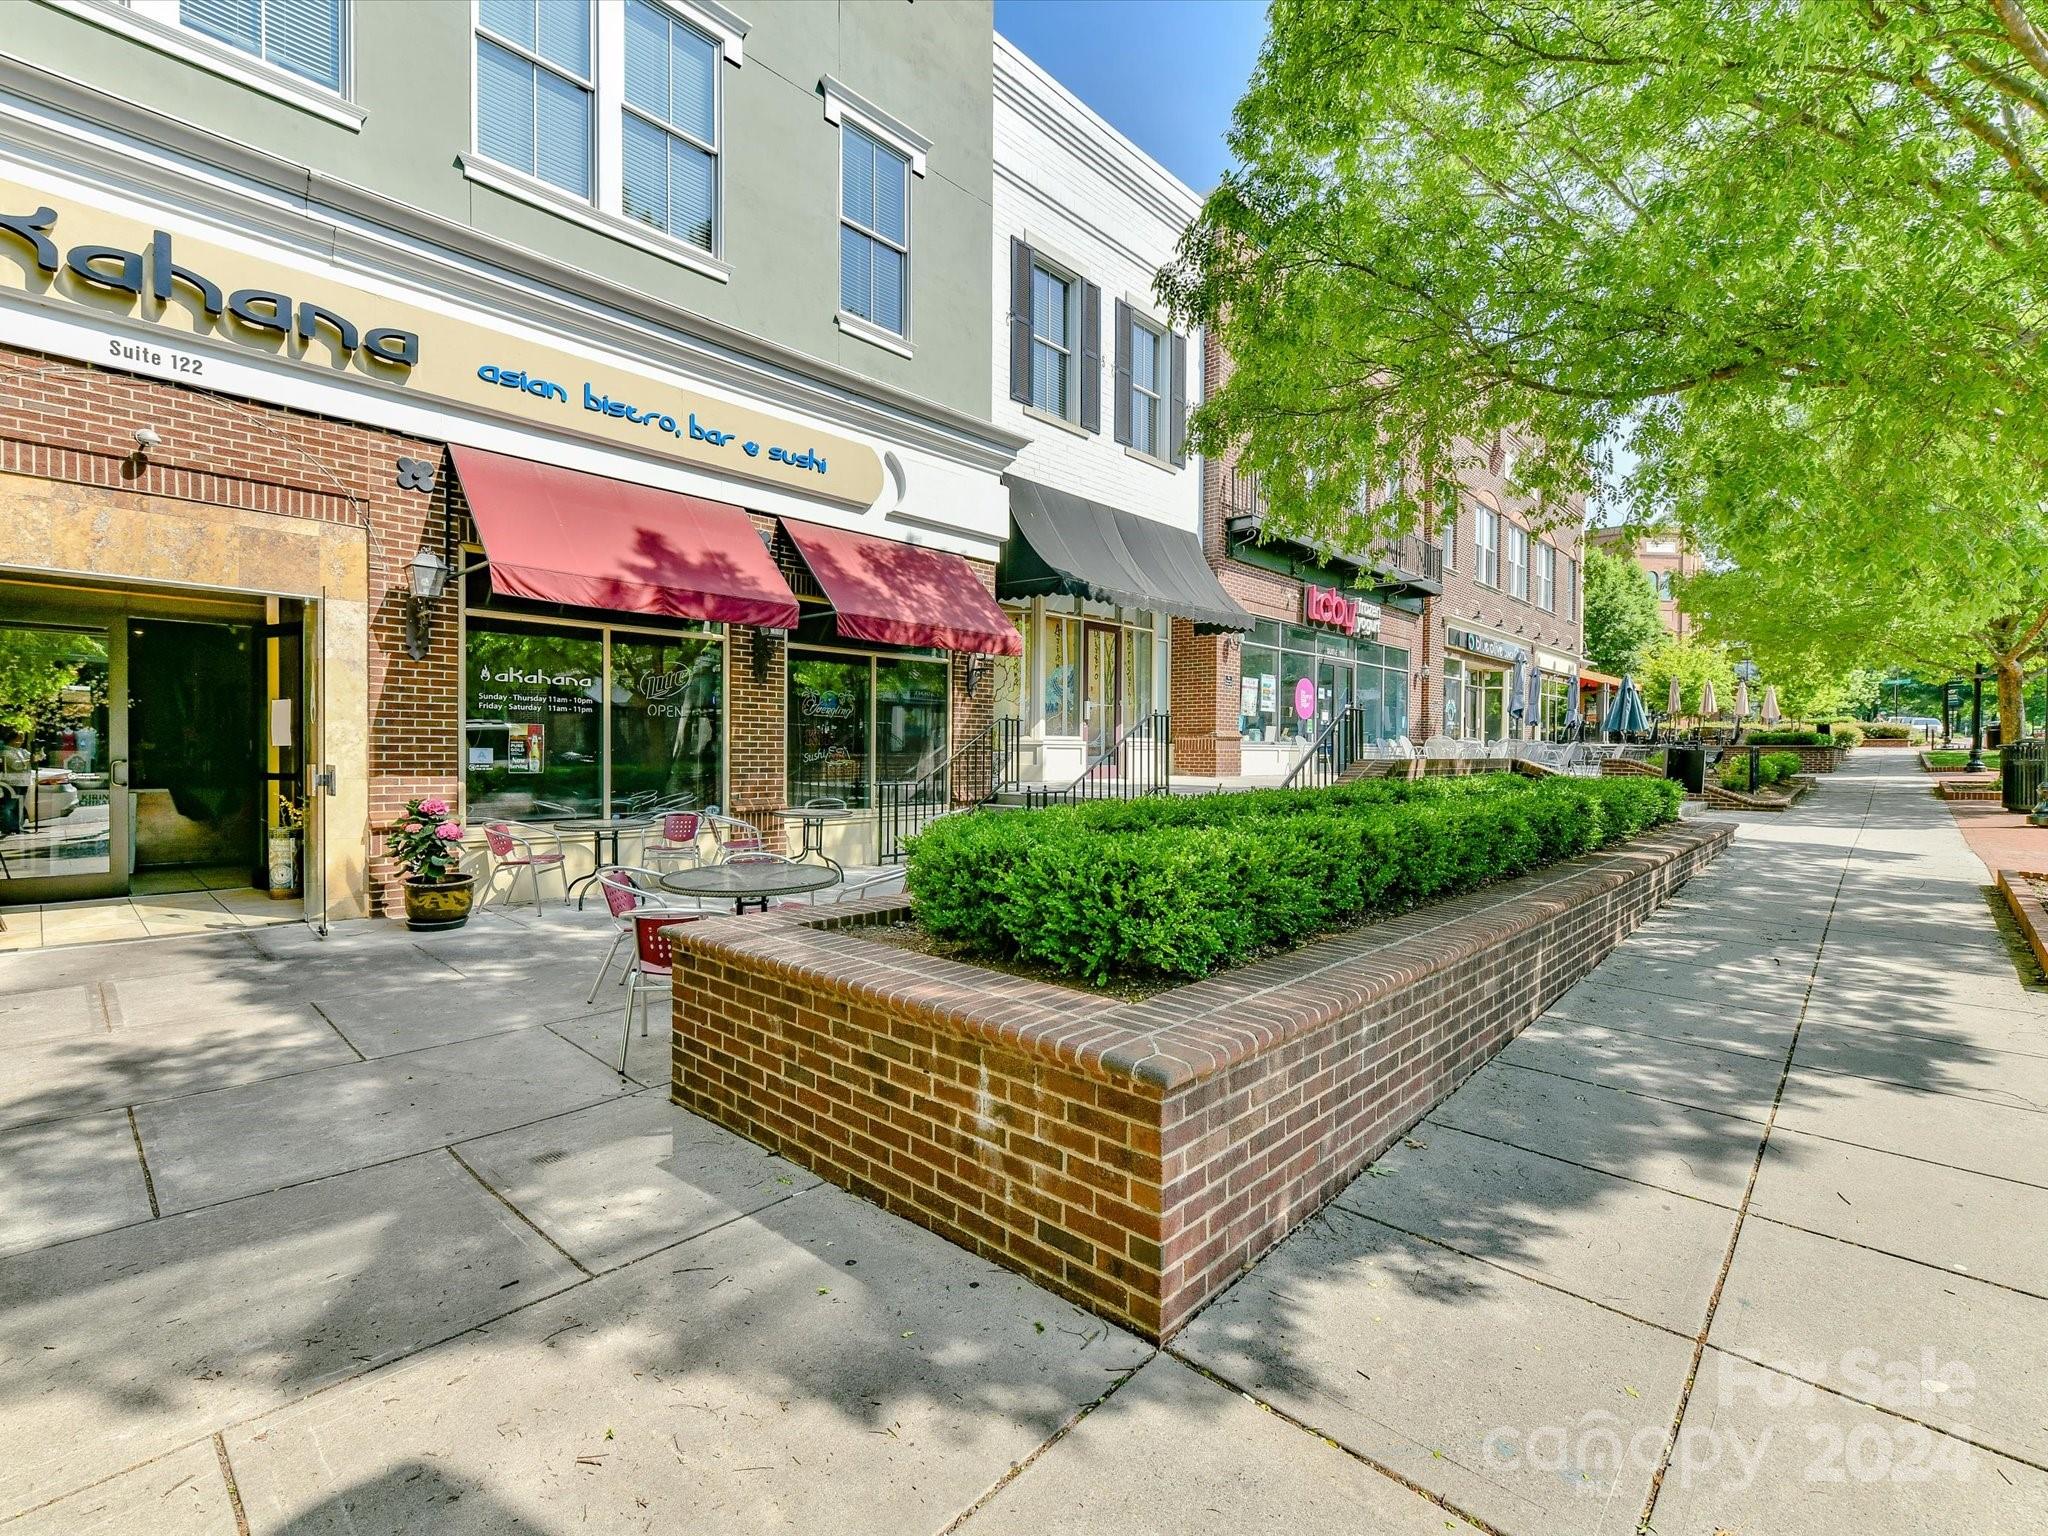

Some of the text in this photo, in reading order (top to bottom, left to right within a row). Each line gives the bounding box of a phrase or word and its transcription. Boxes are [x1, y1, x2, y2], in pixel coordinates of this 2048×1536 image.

[109, 340, 203, 376] Suite 122
[477, 364, 568, 403] asian
[583, 382, 681, 438] bistro,
[688, 413, 736, 447] bar
[768, 447, 827, 474] sushi
[478, 692, 507, 701] Sunday
[513, 694, 547, 703] Thursday
[574, 697, 593, 705] 10pm
[478, 702, 503, 711] Friday
[509, 704, 541, 712] Saturday
[574, 706, 593, 714] 11pm
[647, 704, 684, 717] OPEN
